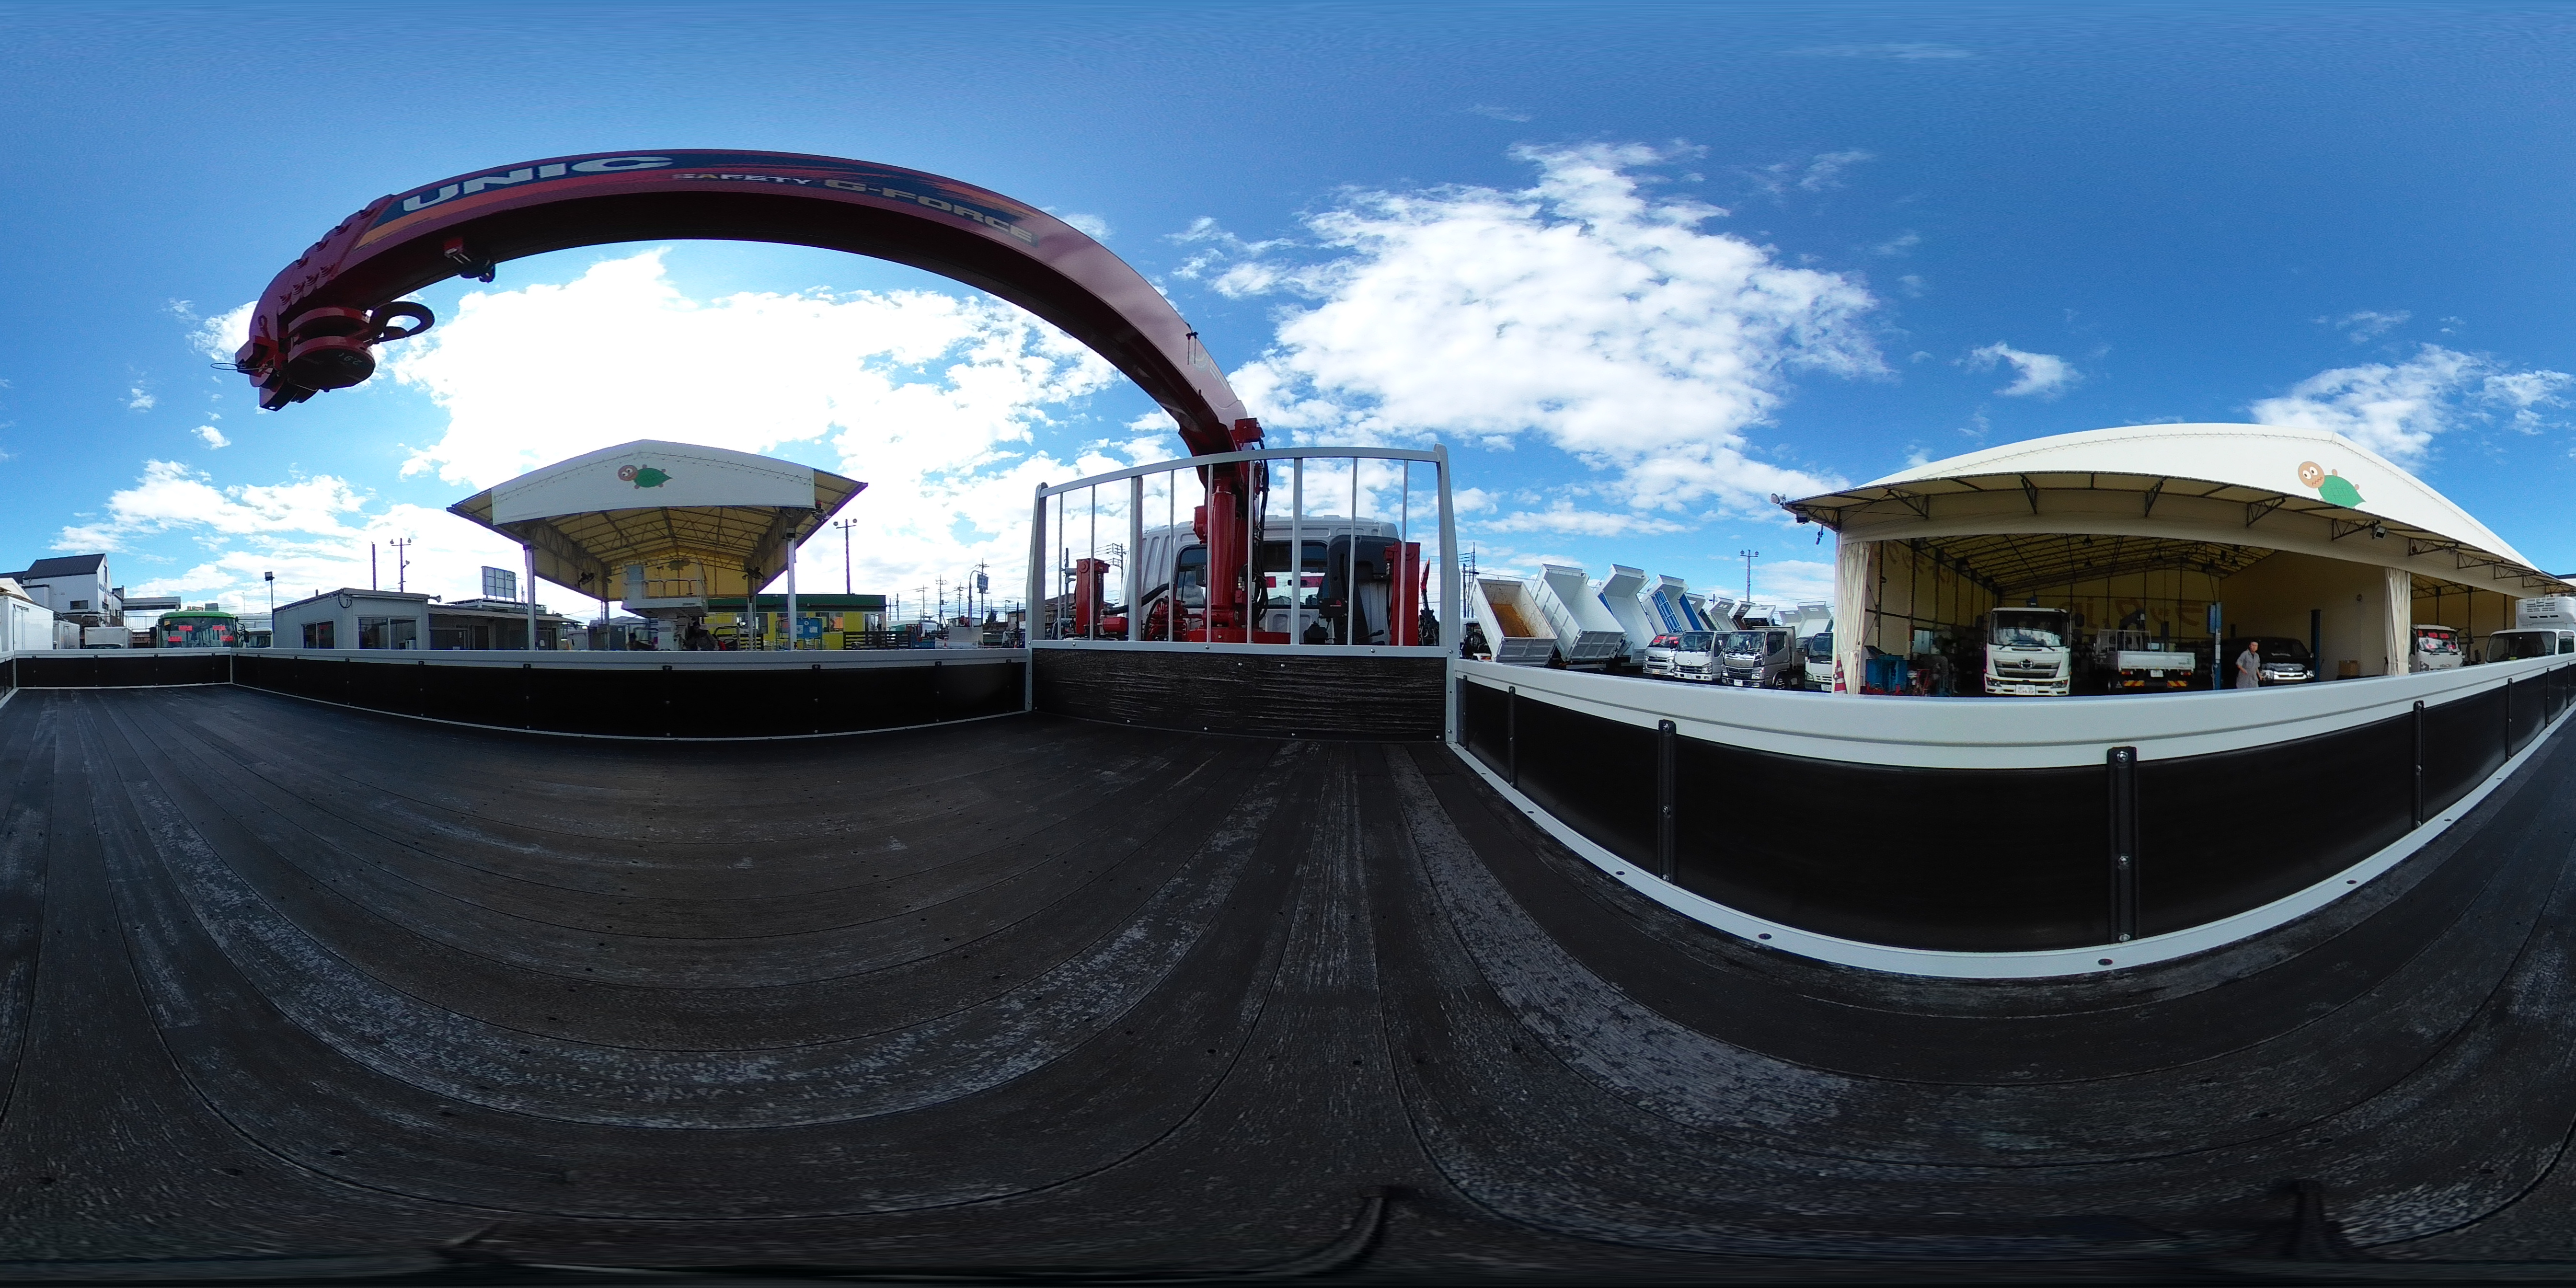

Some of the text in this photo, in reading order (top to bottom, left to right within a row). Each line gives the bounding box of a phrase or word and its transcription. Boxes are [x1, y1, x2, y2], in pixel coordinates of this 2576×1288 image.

[402, 156, 673, 211] UNIC
[672, 174, 1033, 242] SAFETY G-FORCE
